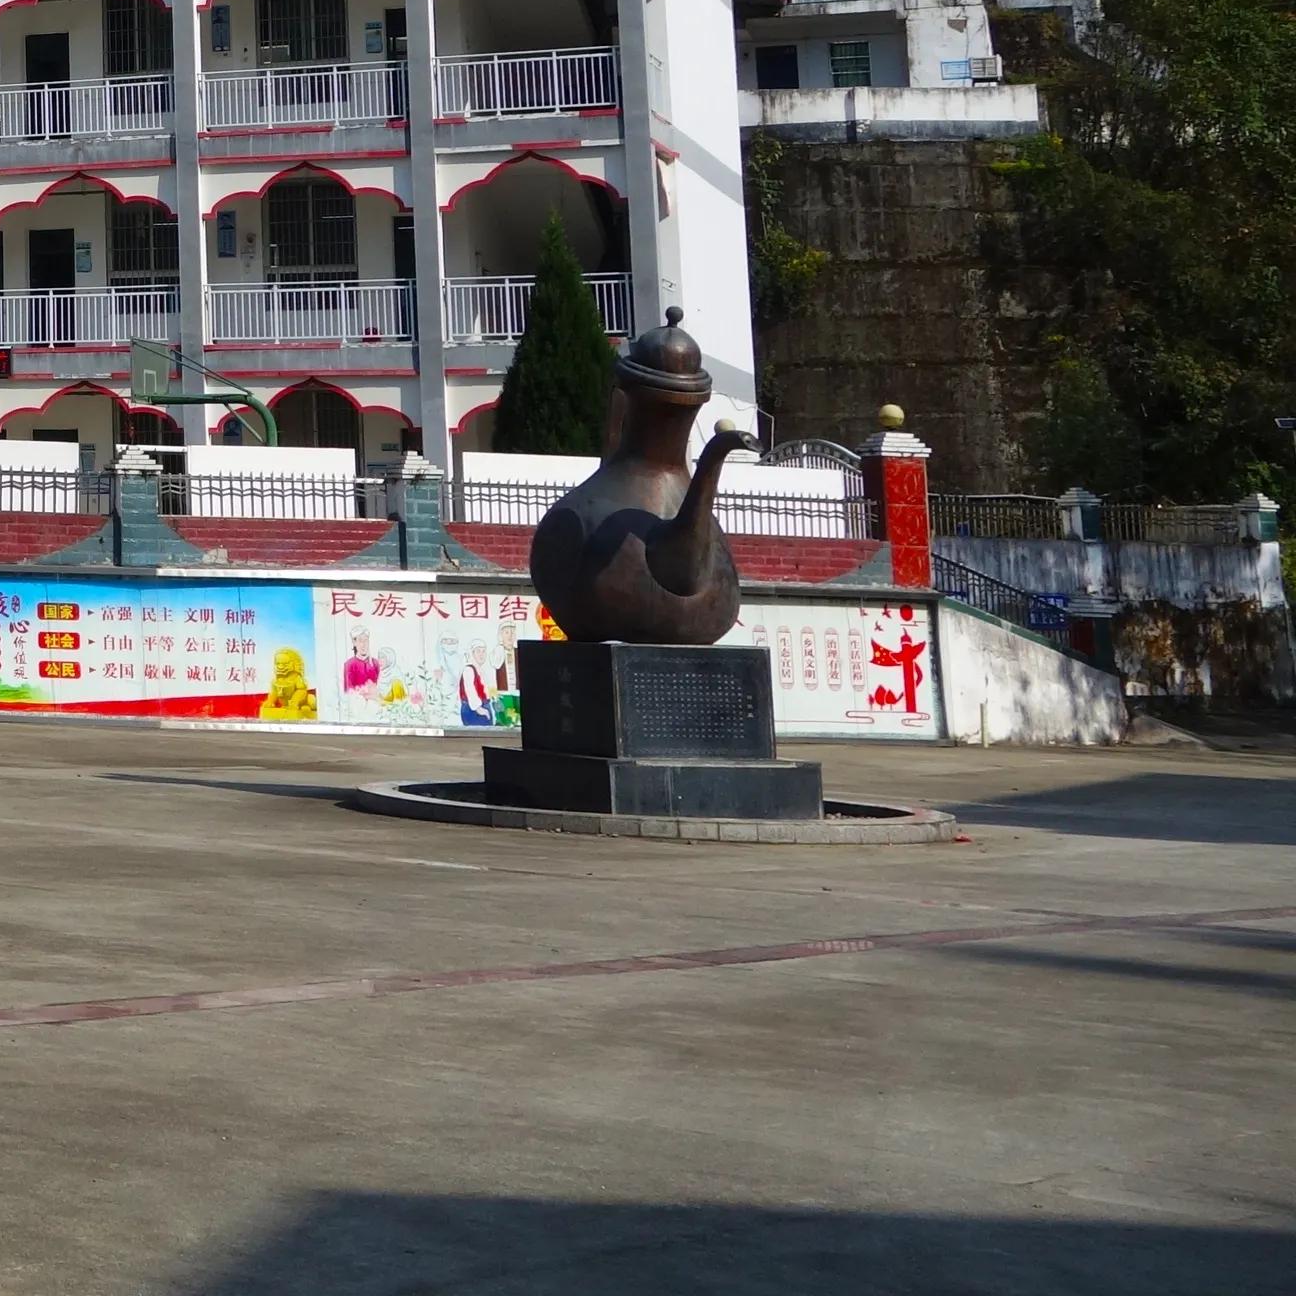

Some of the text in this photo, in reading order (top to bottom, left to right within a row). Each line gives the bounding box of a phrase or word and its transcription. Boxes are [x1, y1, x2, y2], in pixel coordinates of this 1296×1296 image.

[44, 604, 255, 625] 国家 富强 民主 文明 和谐
[331, 592, 531, 621] 民族大团结
[44, 633, 256, 654] 社会 自由 平等 公正 法治
[45, 662, 257, 682] 公民 爱国 敬业 诚信 友善
